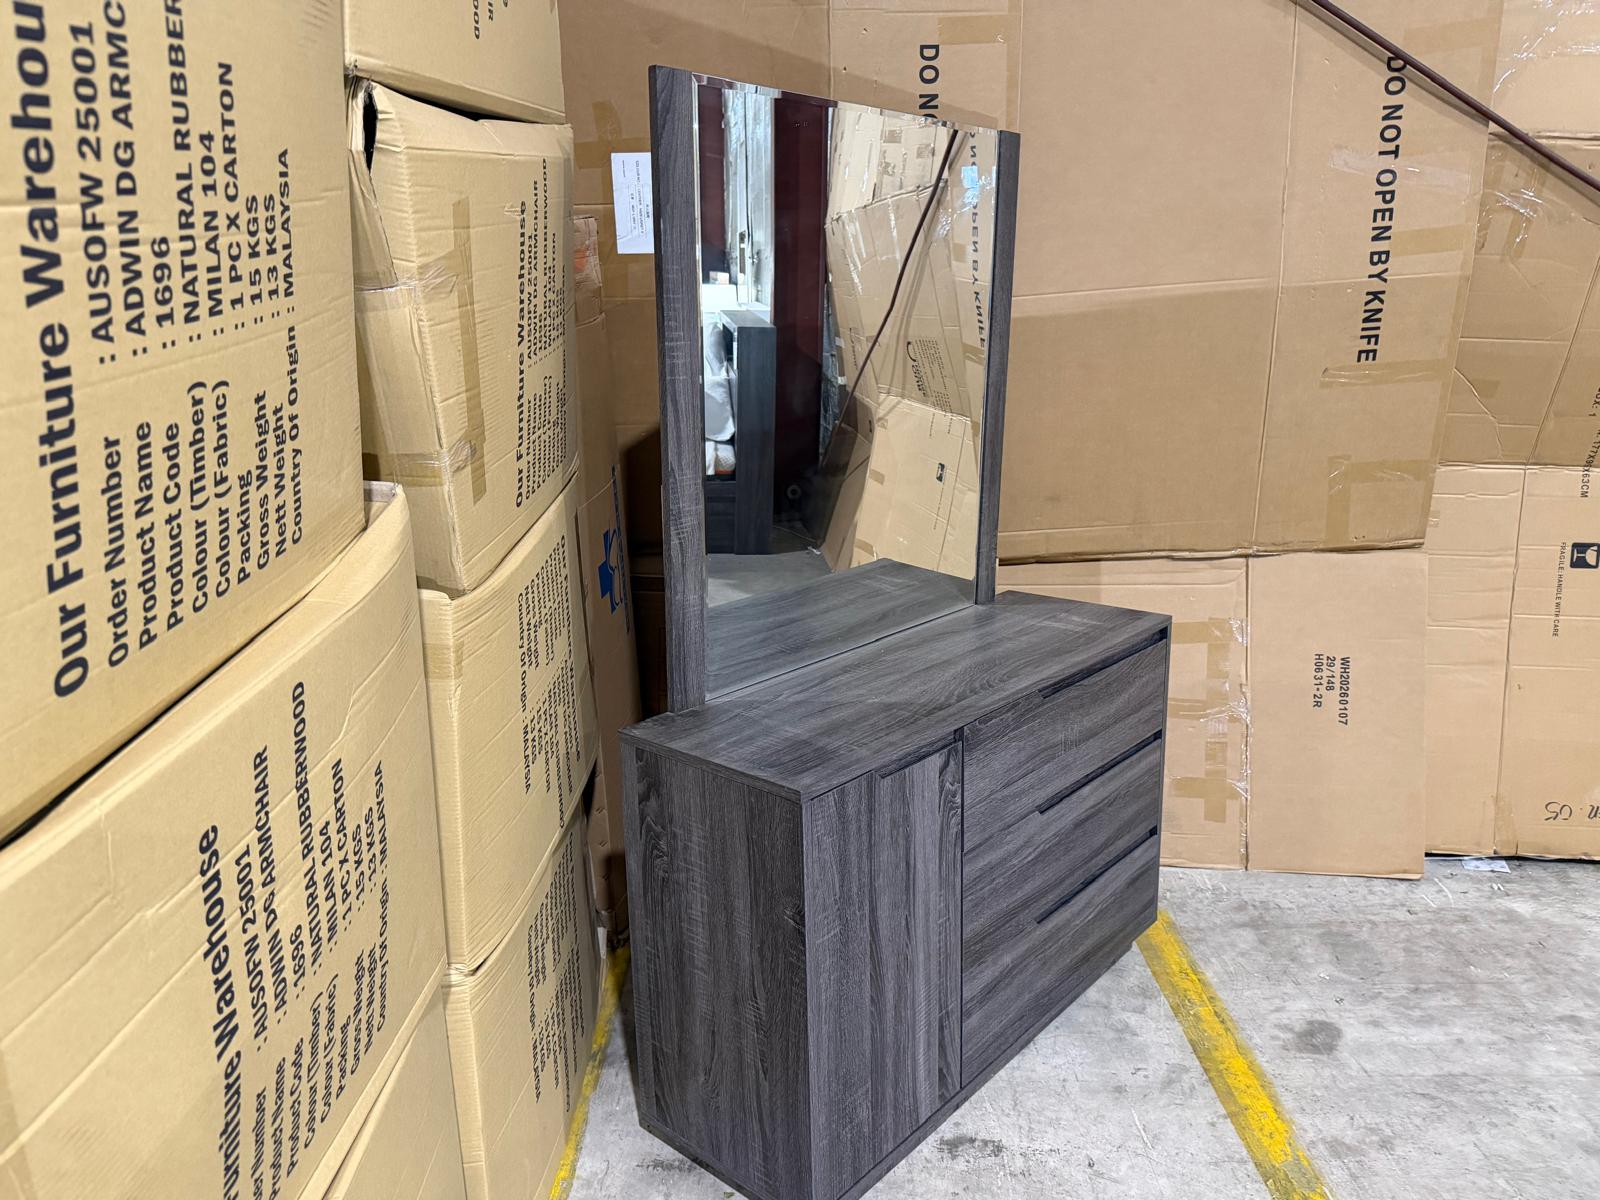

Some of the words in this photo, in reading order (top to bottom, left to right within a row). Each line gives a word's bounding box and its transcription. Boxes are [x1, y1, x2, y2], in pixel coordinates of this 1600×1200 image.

[69, 22, 101, 162] 25001
[919, 45, 939, 84] DO
[1384, 55, 1408, 96] DO
[113, 141, 137, 196] DG
[199, 131, 217, 197] 104
[218, 62, 239, 203] CARTON
[1378, 104, 1404, 160] NOT
[176, 162, 200, 324] NATURAL
[226, 211, 240, 232] X
[245, 195, 261, 259] KGS
[263, 194, 277, 256] KGS
[278, 149, 294, 298] MALAYSIA
[1371, 169, 1397, 242] OPEN
[79, 172, 114, 343] AUSOFW
[117, 210, 146, 336] ADWIN
[150, 236, 175, 328] 1696
[203, 210, 223, 318] MILAN
[228, 241, 243, 284] PC
[249, 268, 263, 305] 15
[267, 265, 279, 301] 13
[517, 201, 526, 347] Warehouse
[1368, 250, 1390, 283] BY
[230, 292, 244, 310] 1
[1357, 290, 1386, 363] KNIFE
[286, 325, 299, 407] Origin
[211, 380, 232, 499] (Fabric)
[254, 390, 270, 492] Weight
[285, 413, 299, 443] Of
[516, 352, 524, 462] Furniture
[39, 323, 84, 594] Furniture
[134, 422, 154, 520] Name
[162, 422, 181, 505] Code
[187, 381, 210, 511] (Timber)
[272, 402, 287, 500] Weight
[531, 437, 539, 495] Product
[100, 436, 125, 573] Number
[236, 469, 253, 585] Packing
[257, 493, 270, 570] Gross
[275, 499, 287, 558] Nett
[290, 448, 302, 545] Country
[136, 521, 157, 650] Product
[164, 508, 184, 632] Product
[192, 519, 208, 613] Colour
[215, 507, 230, 598] Colour
[1555, 574, 1563, 600] HANDLE
[54, 603, 89, 697] Our
[107, 578, 129, 667] Order
[1552, 620, 1560, 637] CARE
[1313, 653, 1324, 708] H0631-2R
[1325, 656, 1336, 691] 29/148
[1338, 656, 1350, 726] WH20260107
[292, 681, 314, 861] RUBBERWOOD
[523, 723, 531, 794] MALAYSIA
[253, 745, 276, 889] ARMCHAIR
[331, 758, 348, 852] CARTON
[364, 806, 375, 854] KGS
[374, 760, 387, 866] MALAYSIA
[319, 820, 333, 867] 104
[338, 849, 349, 873] X
[352, 823, 364, 872] KGS
[368, 852, 377, 882] 13
[235, 843, 257, 934] 25001
[263, 888, 278, 933] DG
[303, 856, 323, 967] NATURAL
[323, 867, 338, 945] MILAN
[340, 869, 352, 905] PC
[342, 902, 352, 921] 1
[355, 870, 365, 901] 15
[379, 877, 389, 938] Origin
[199, 825, 239, 1062] Warehouse
[267, 928, 287, 1013] ADWIN
[289, 924, 306, 988] 1696
[366, 942, 380, 1015] Weight
[379, 936, 387, 963] Of
[243, 933, 268, 1040] AUSOFW
[323, 973, 339, 1059] (Fabric)
[352, 949, 366, 1024] Weight
[377, 959, 389, 1032] Country
[289, 1037, 304, 1097] Code
[307, 990, 327, 1084] (Timber)
[336, 1014, 351, 1100] Packing
[350, 1017, 362, 1076] Gross
[364, 1008, 375, 1055] Nett
[218, 1050, 241, 1200] urniture
[271, 1057, 286, 1127] Name
[304, 1080, 318, 1149] Colour
[320, 1056, 334, 1124] Colour
[251, 1086, 266, 1179] Number
[286, 1090, 301, 1178] Product
